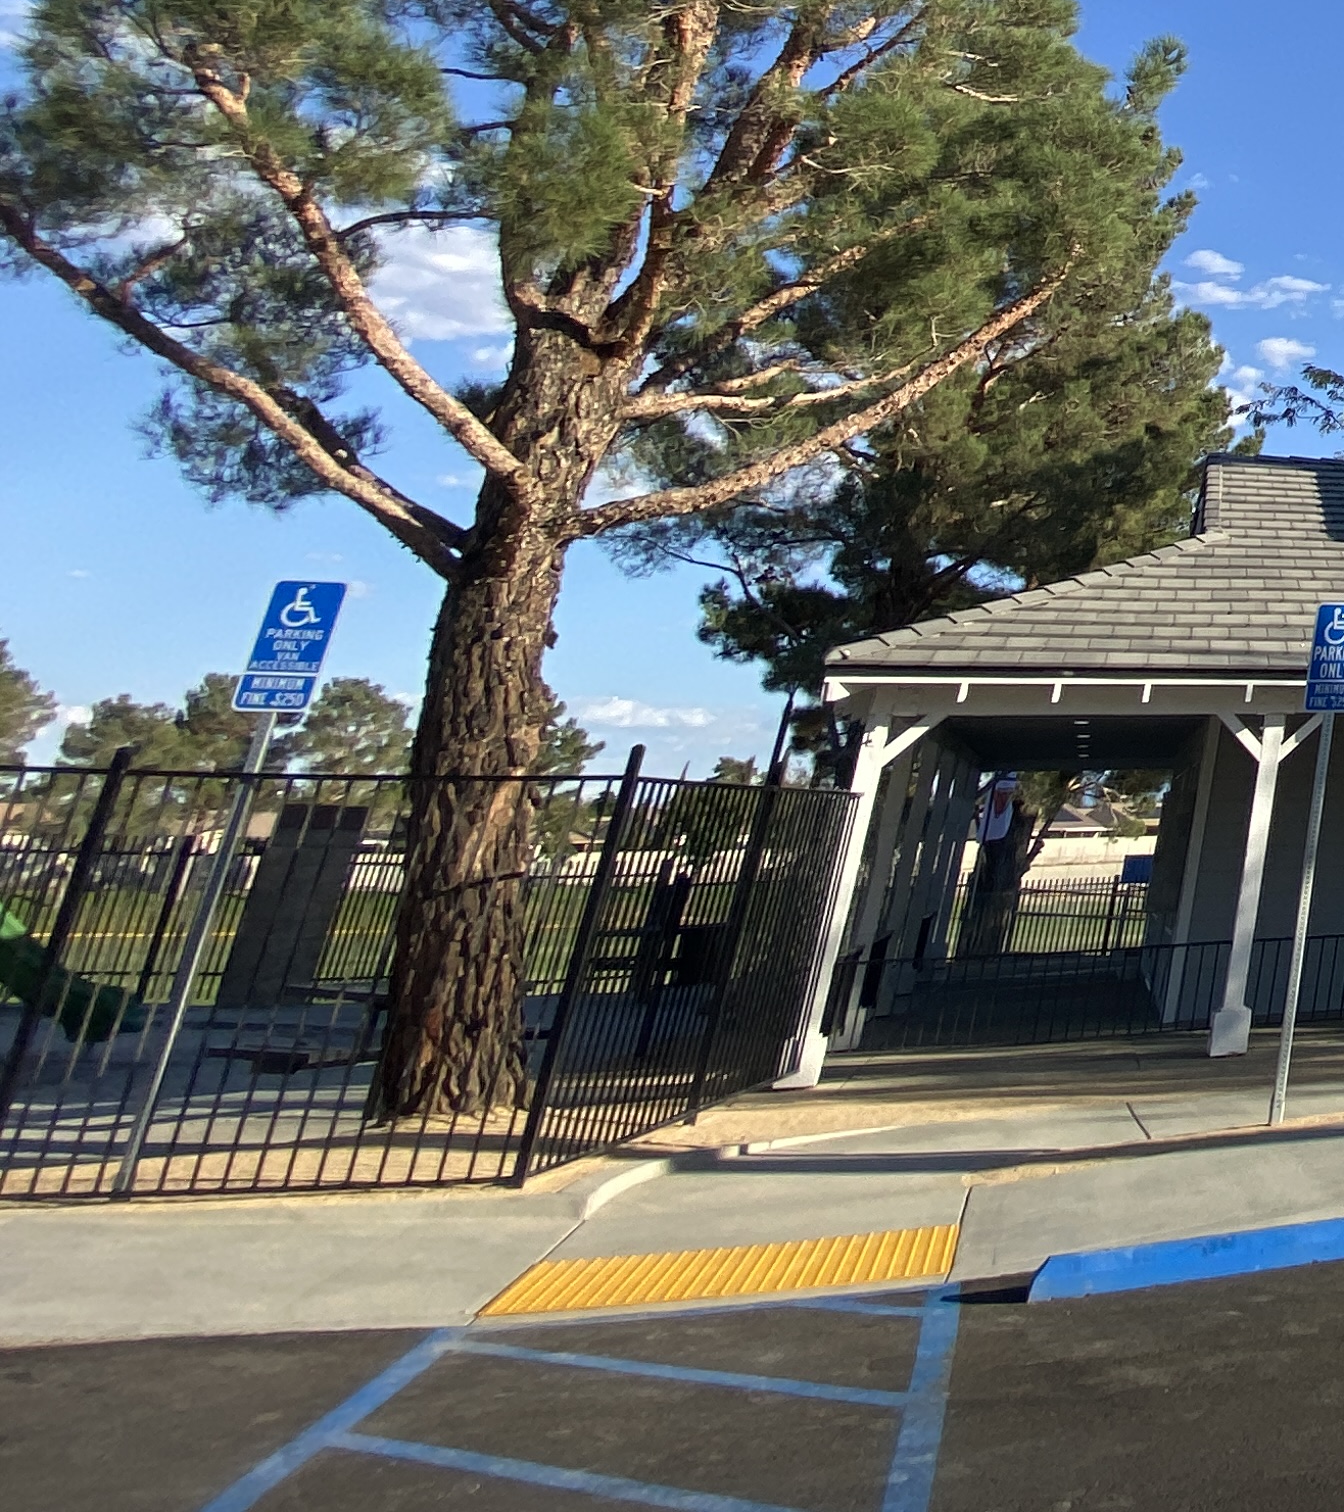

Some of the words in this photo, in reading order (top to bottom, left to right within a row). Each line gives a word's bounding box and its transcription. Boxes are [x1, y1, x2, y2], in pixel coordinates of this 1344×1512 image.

[264, 628, 325, 641] PARKING
[272, 640, 311, 651] ONLY
[276, 652, 301, 661] VAN
[248, 660, 320, 671] ACCESSIBLE
[250, 676, 306, 690] MINIMUM
[239, 691, 269, 705] FINE
[269, 691, 305, 707] $250
[1308, 696, 1329, 708] FINE
